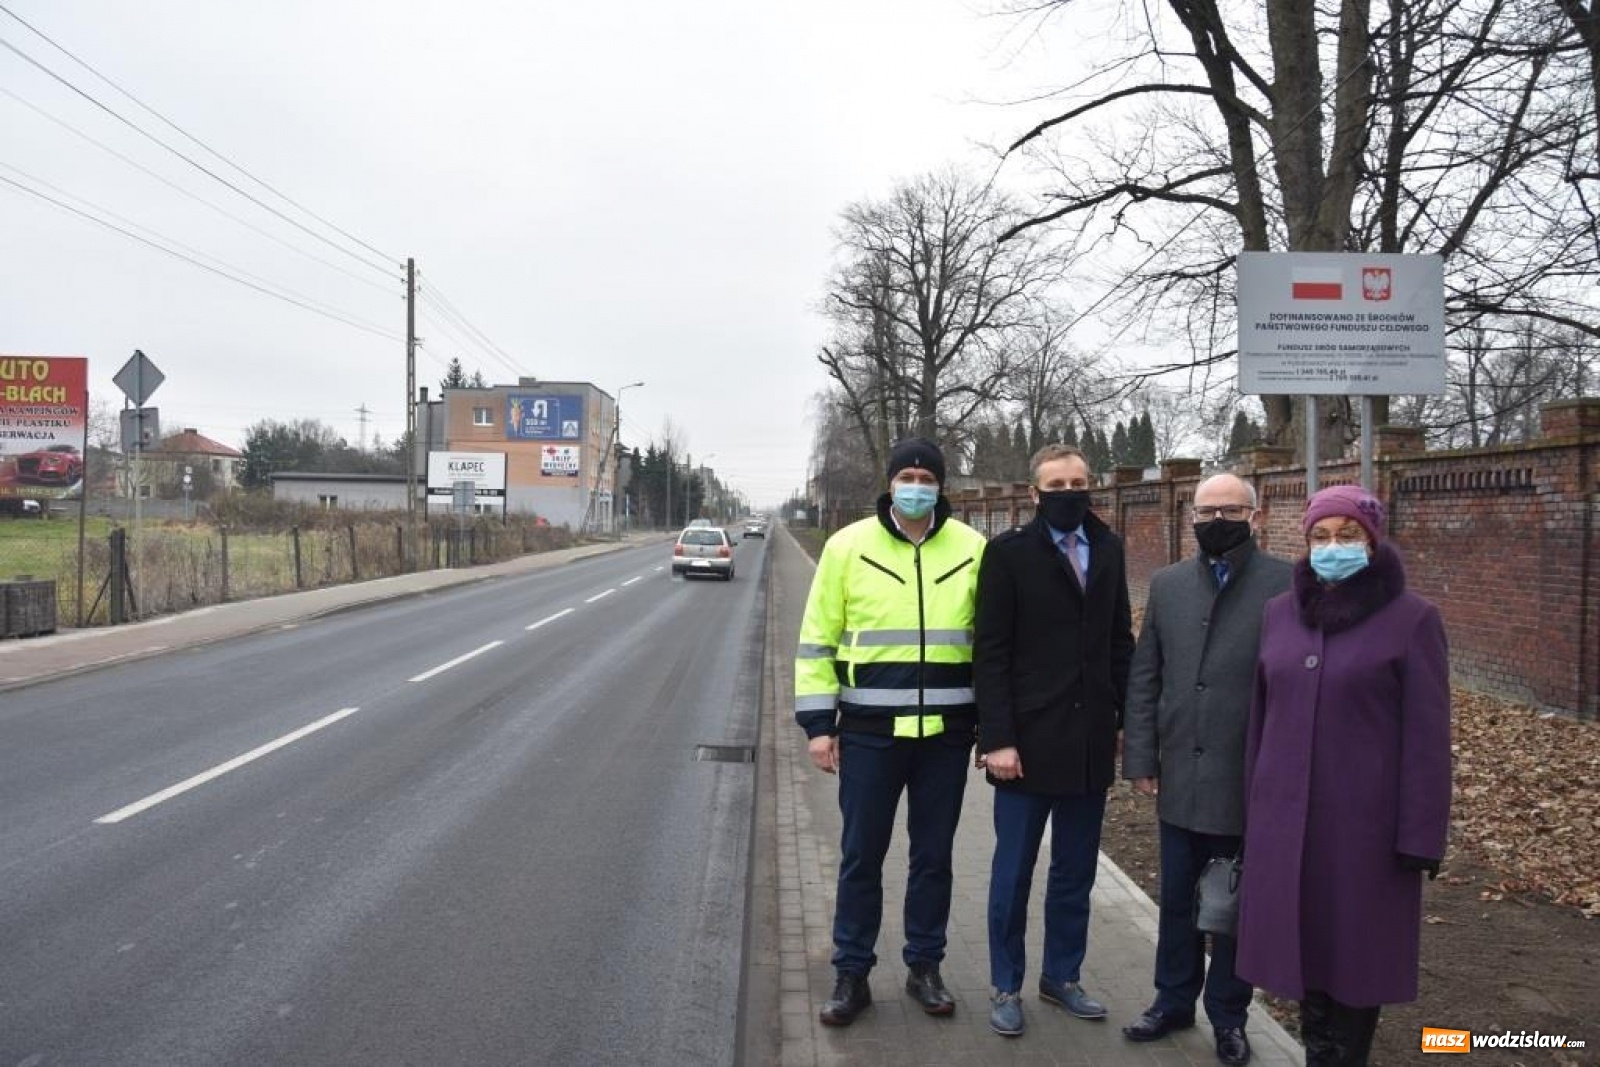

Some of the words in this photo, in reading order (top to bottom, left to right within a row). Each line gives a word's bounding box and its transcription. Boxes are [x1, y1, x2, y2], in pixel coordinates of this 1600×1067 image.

[1270, 313, 1354, 321] DOFINANSOWANO
[1355, 313, 1366, 321] ZE
[1369, 312, 1415, 322] ŚRODKÓW
[1255, 322, 1329, 331] PAŃSTWOWEGO
[1331, 323, 1377, 332] FUNDUSZU
[1379, 324, 1429, 332] CELOWEGO
[16, 419, 71, 427] PLASTIKU
